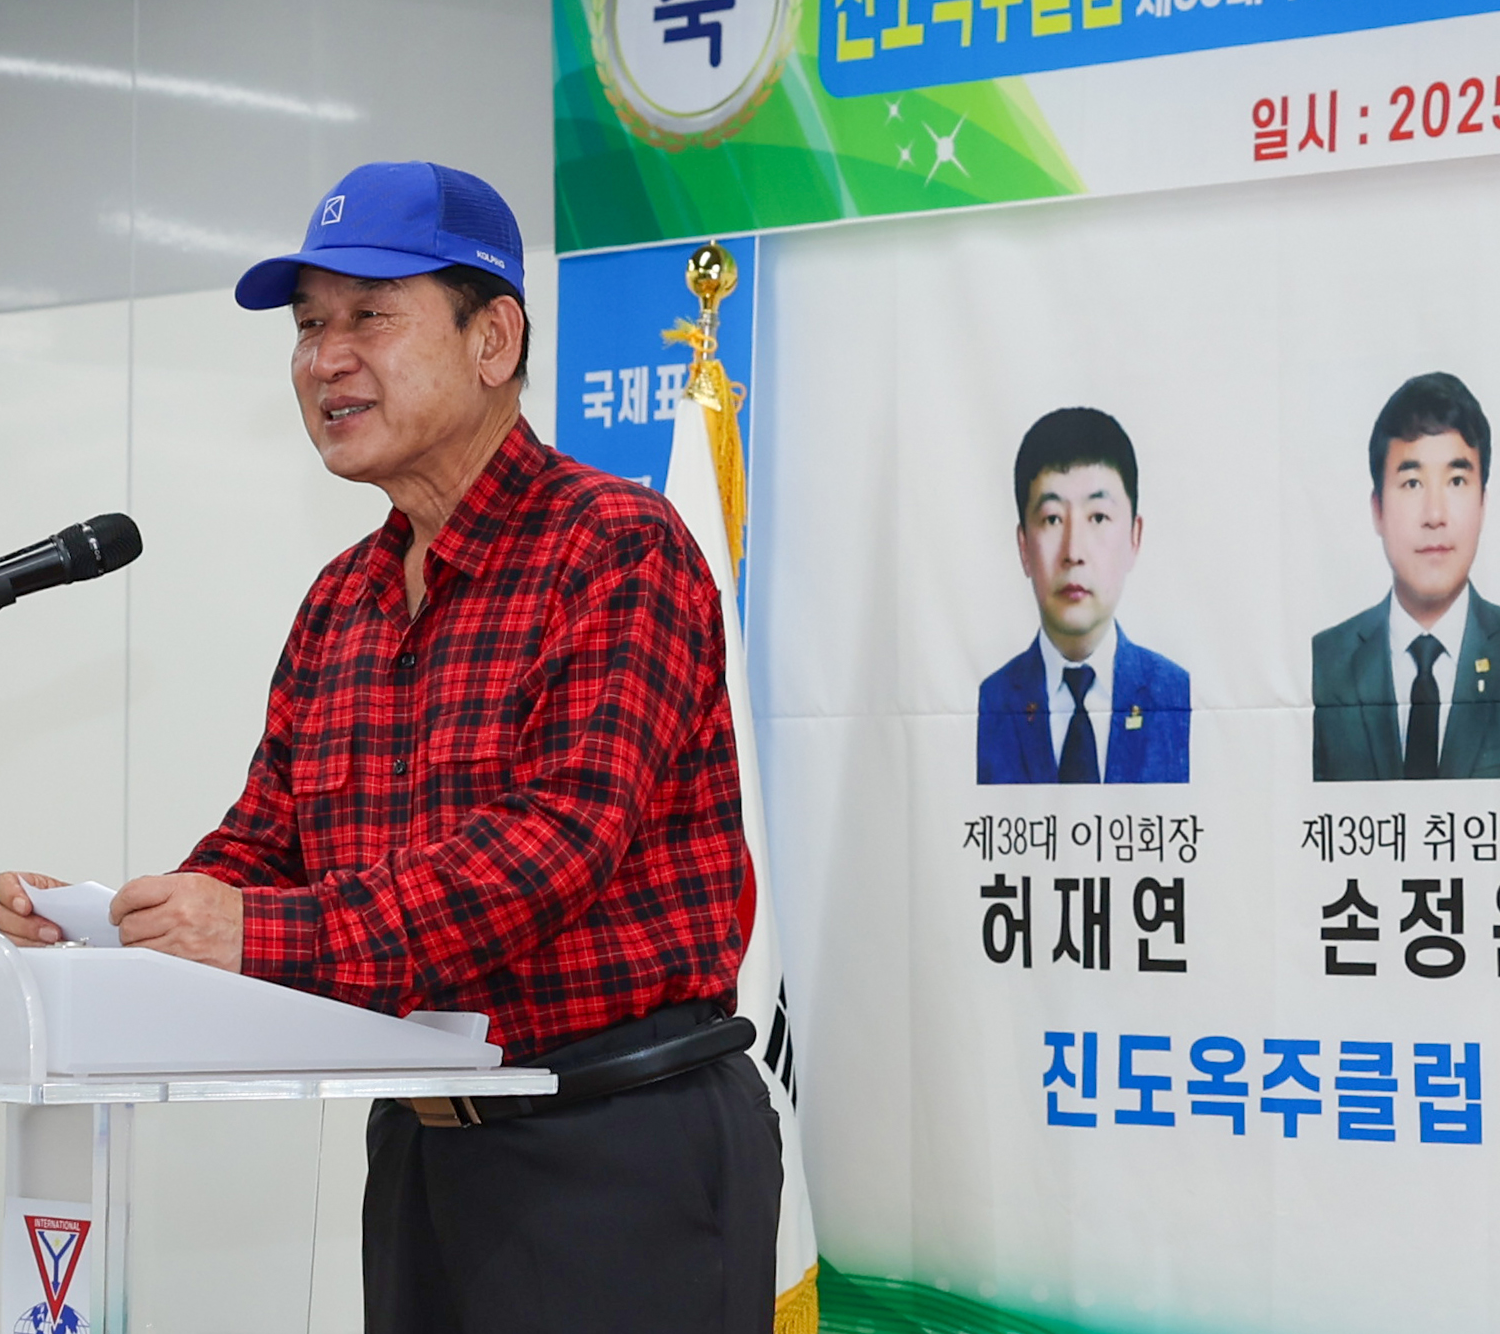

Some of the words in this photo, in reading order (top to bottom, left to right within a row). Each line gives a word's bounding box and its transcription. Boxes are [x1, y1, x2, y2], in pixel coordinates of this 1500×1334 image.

[1252, 91, 1337, 161] 일시
[963, 814, 1057, 862] 제38대
[1071, 814, 1204, 864] 이임회장
[1301, 812, 1406, 863] 제39대
[1043, 1031, 1483, 1145] 진도옥주클럽
